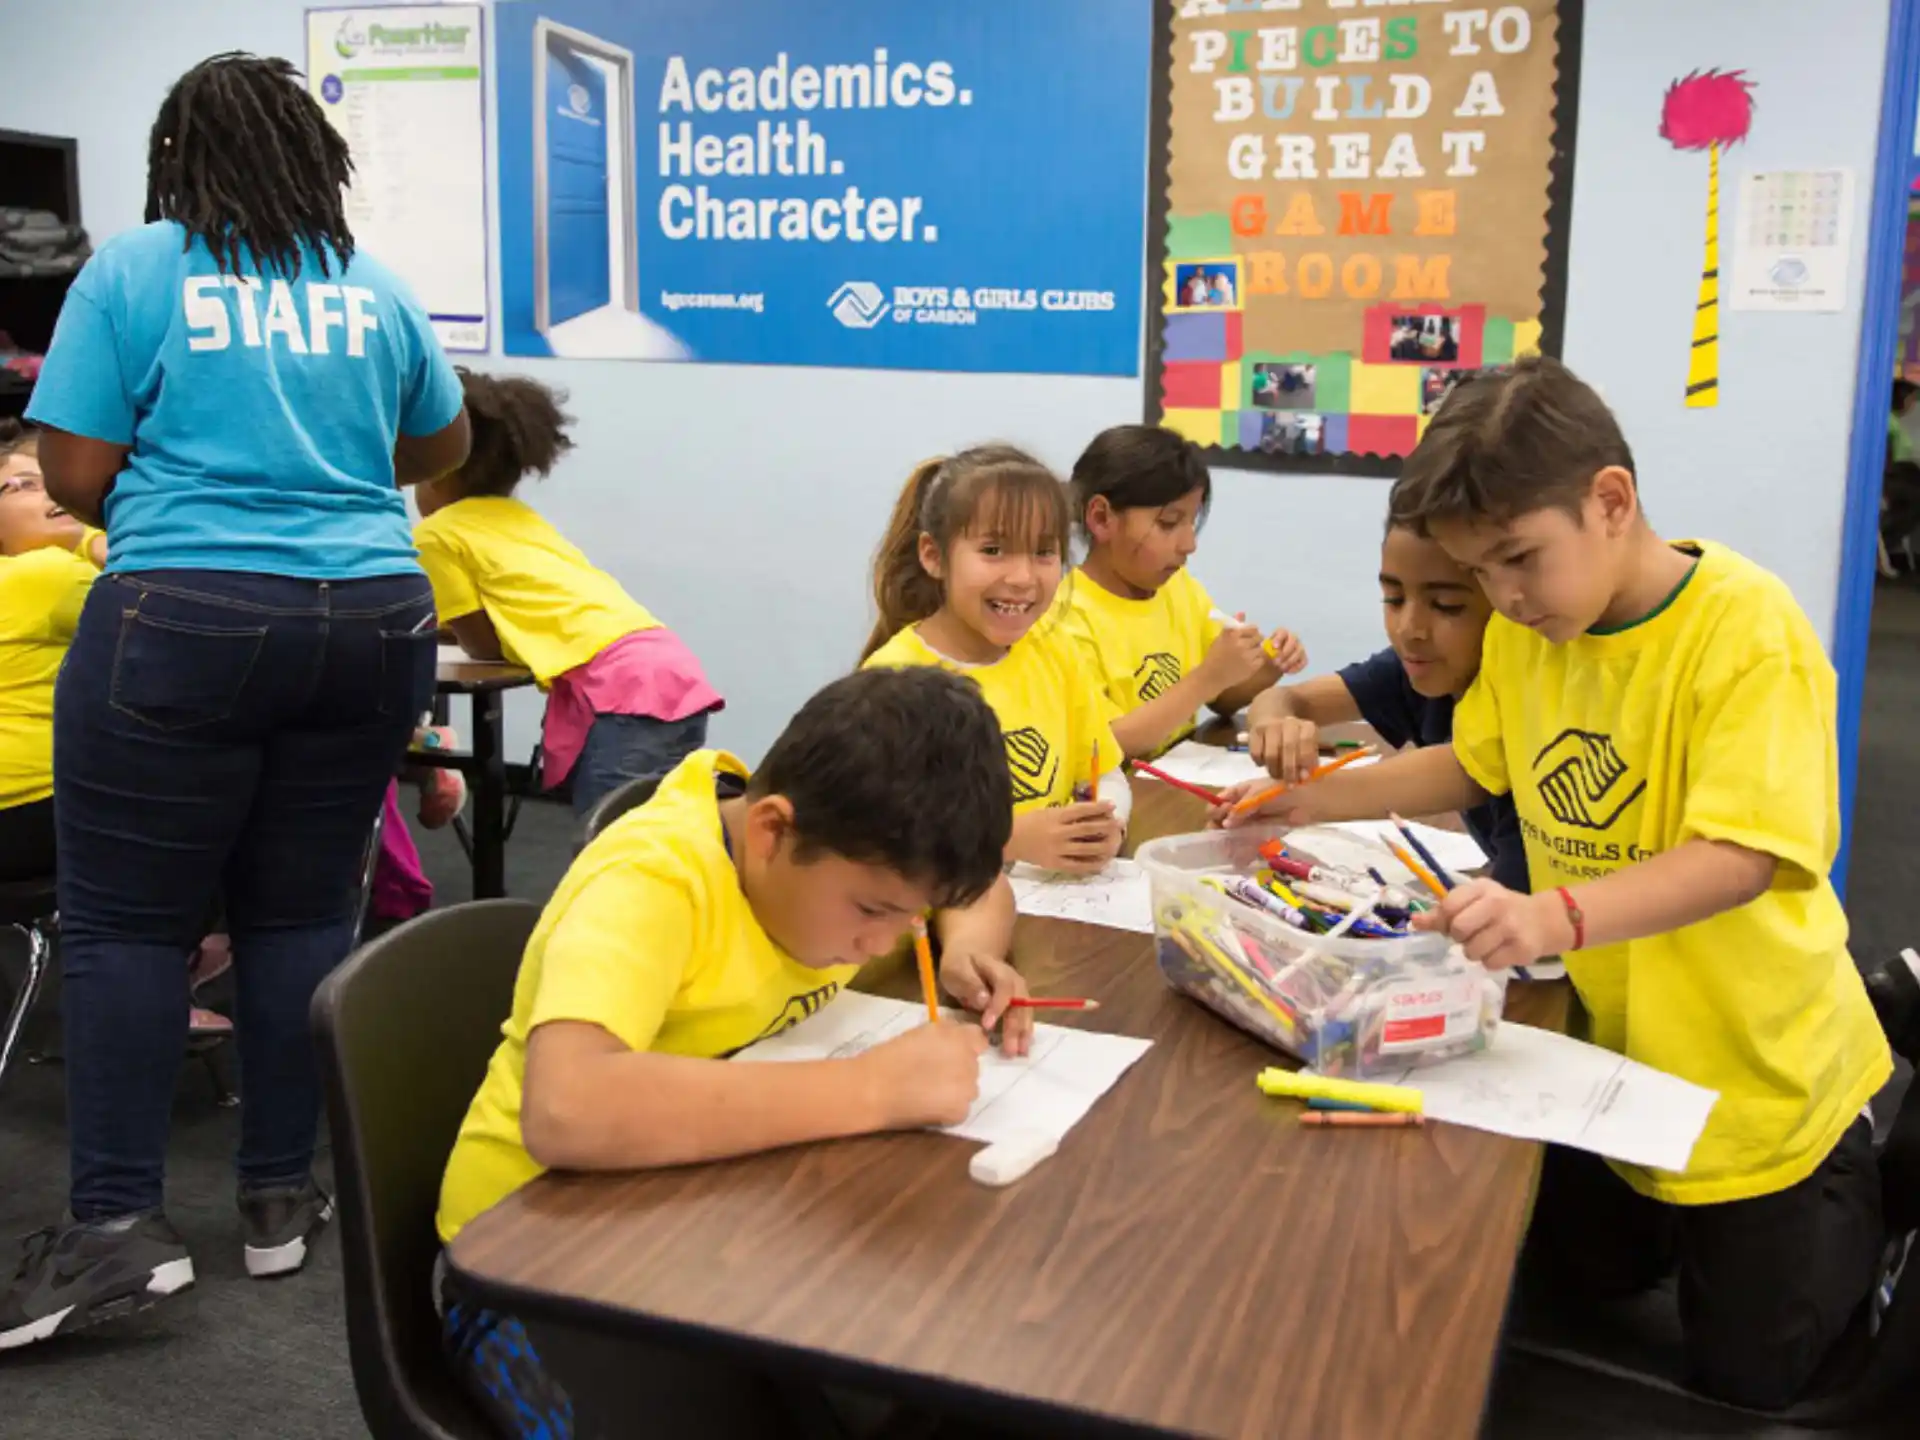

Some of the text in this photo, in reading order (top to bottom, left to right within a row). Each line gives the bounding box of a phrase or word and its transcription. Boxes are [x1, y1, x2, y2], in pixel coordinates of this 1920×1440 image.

[1189, 6, 1531, 72] PIECES TO
[659, 48, 973, 113] Academics.
[1213, 71, 1505, 121] BUILD A
[659, 119, 844, 176] Health.
[1227, 132, 1486, 180] GREAT
[659, 184, 938, 242] Character.
[1231, 189, 1457, 237] GAME
[893, 286, 1115, 311] BOYS & GIRLS CLUBS
[1246, 251, 1452, 299] ROOM
[183, 275, 378, 357] STAFF
[893, 309, 976, 325] OF CARSON
[1553, 836, 1621, 861] GIRLS
